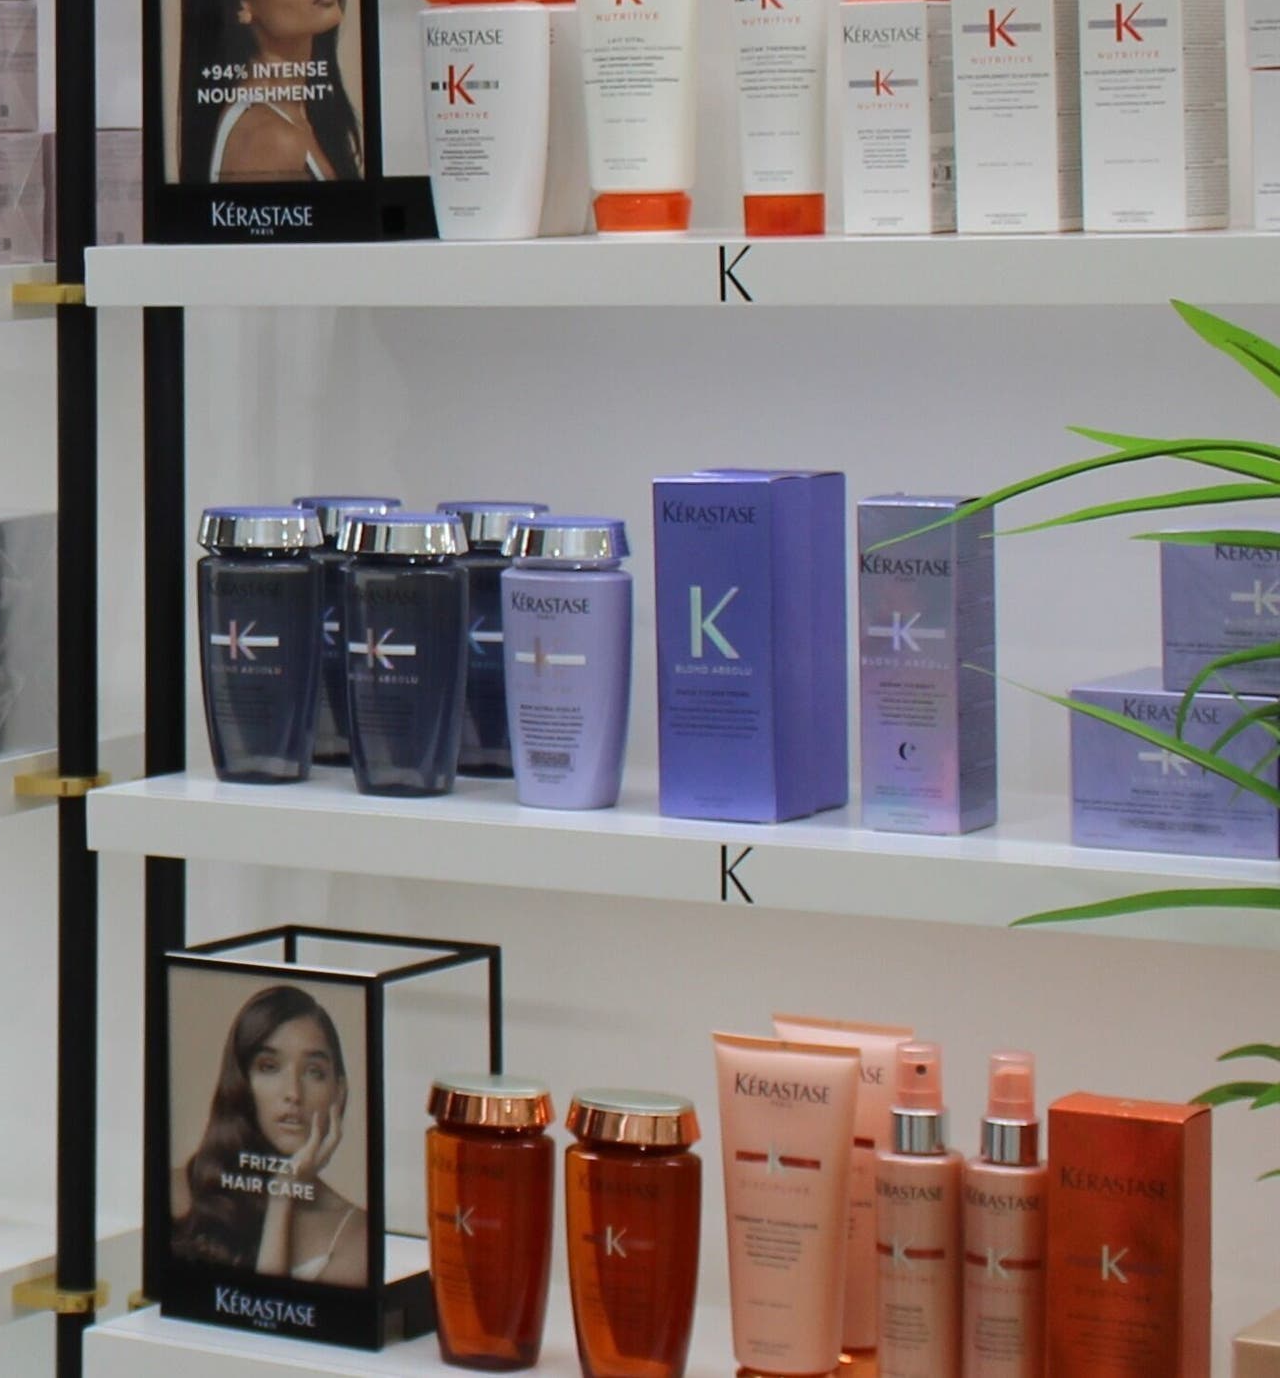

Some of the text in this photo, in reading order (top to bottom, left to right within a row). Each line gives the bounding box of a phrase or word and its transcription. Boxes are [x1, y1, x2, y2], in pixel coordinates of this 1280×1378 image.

[595, 11, 660, 23] NUTRITIVE
[988, 6, 1018, 49] K
[1114, 1, 1145, 43] K
[426, 26, 504, 47] KÉRASTASE
[842, 24, 923, 45] KÉRASTASE
[201, 60, 329, 82] +94% INTENSE
[447, 63, 476, 106] K
[873, 68, 895, 97] K
[211, 201, 314, 228] KÉRASTASE
[718, 244, 753, 303] K
[662, 500, 757, 524] KÉRASTASE
[860, 552, 952, 577] KÉRASTASE
[510, 590, 591, 615] KÉRASTASE
[228, 619, 257, 660] K
[690, 585, 740, 660] K
[892, 610, 922, 652] K
[366, 627, 394, 669] K
[721, 844, 754, 904] K
[734, 1072, 831, 1105] KÉRASTASE
[239, 1152, 301, 1176] FRIZZY
[220, 1172, 316, 1202] HAIR CARE
[1059, 1165, 1170, 1200] KÉRASTASE
[454, 1204, 475, 1238] K
[604, 1224, 628, 1259] K
[1101, 1243, 1130, 1284] K
[215, 1284, 316, 1327] KÉRASTASE
